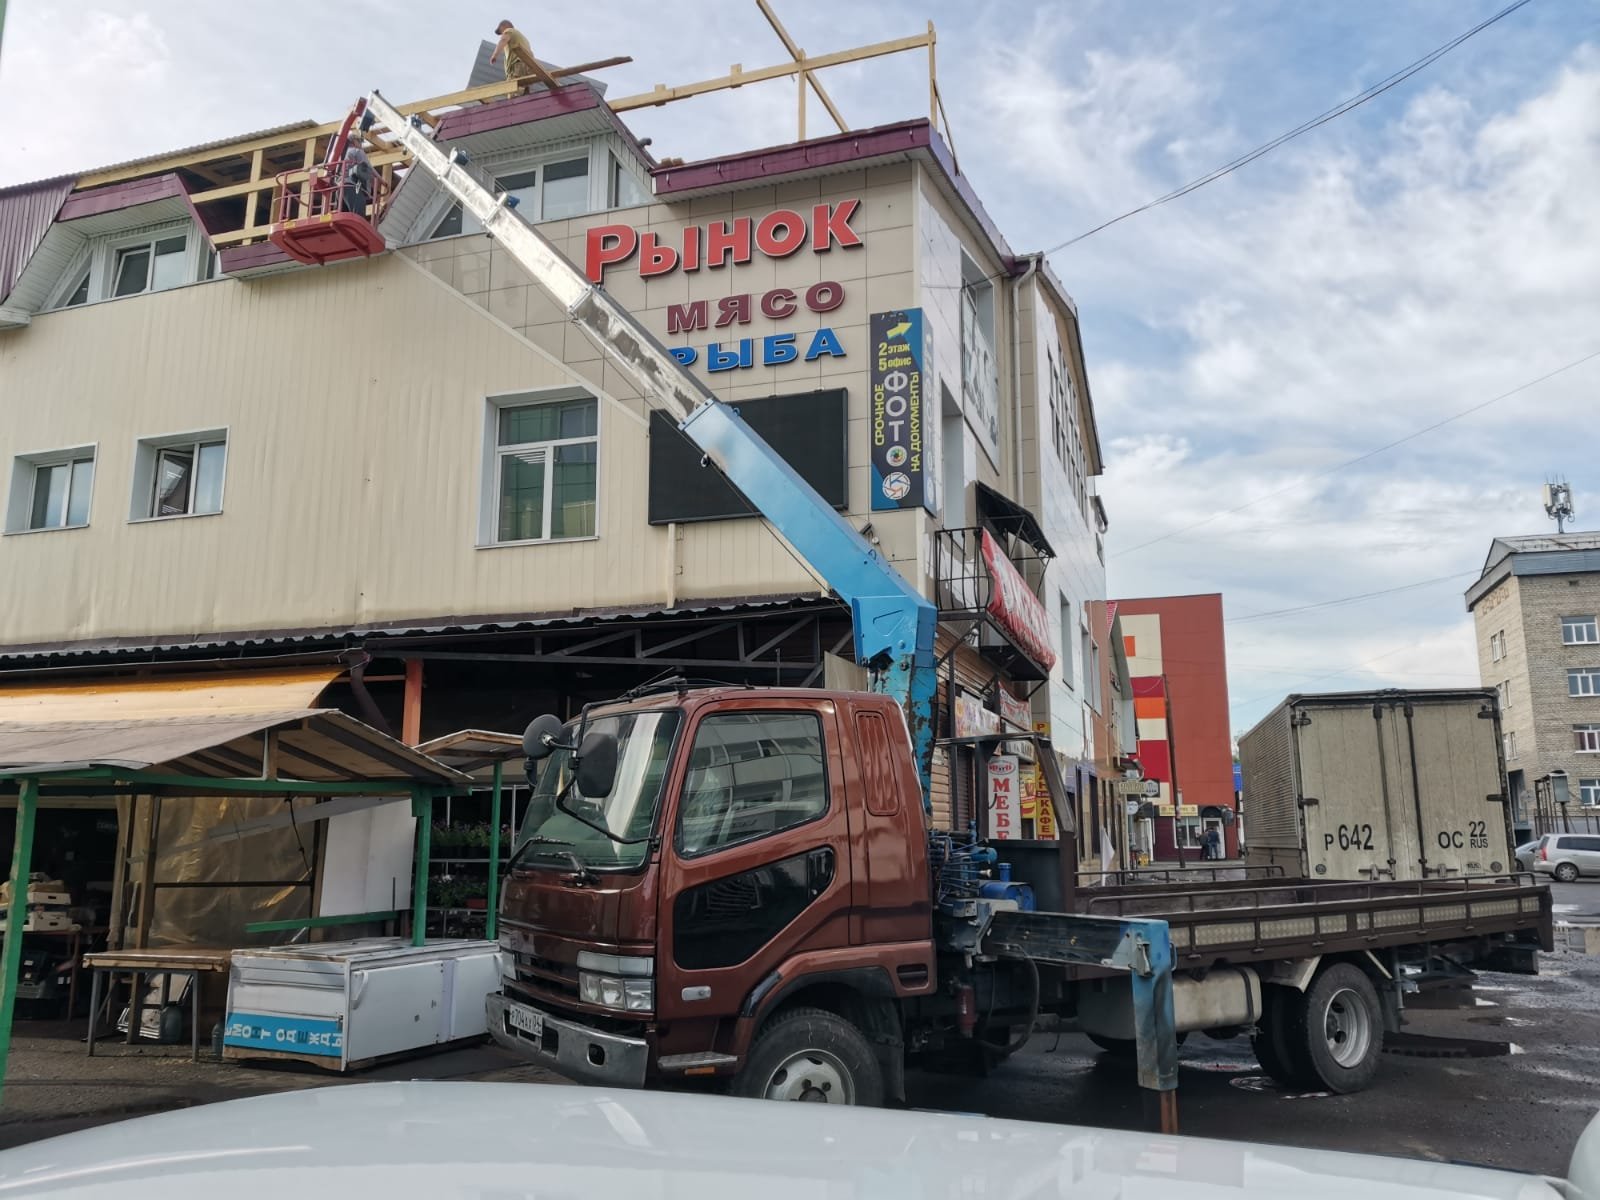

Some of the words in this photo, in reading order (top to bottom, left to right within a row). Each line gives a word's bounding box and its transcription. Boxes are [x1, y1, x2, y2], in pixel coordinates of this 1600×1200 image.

[667, 281, 845, 333] МЯСО
[879, 342, 888, 356] 2
[879, 358, 888, 372] 5
[874, 384, 884, 446] СРОЧНОЕ
[910, 371, 922, 452] ДОКУМЕНТЫ
[911, 453, 920, 472] НА
[1040, 799, 1051, 833] КАФЕ
[1338, 824, 1374, 850] 642
[1469, 821, 1487, 837] 22
[1470, 838, 1489, 849] RUS
